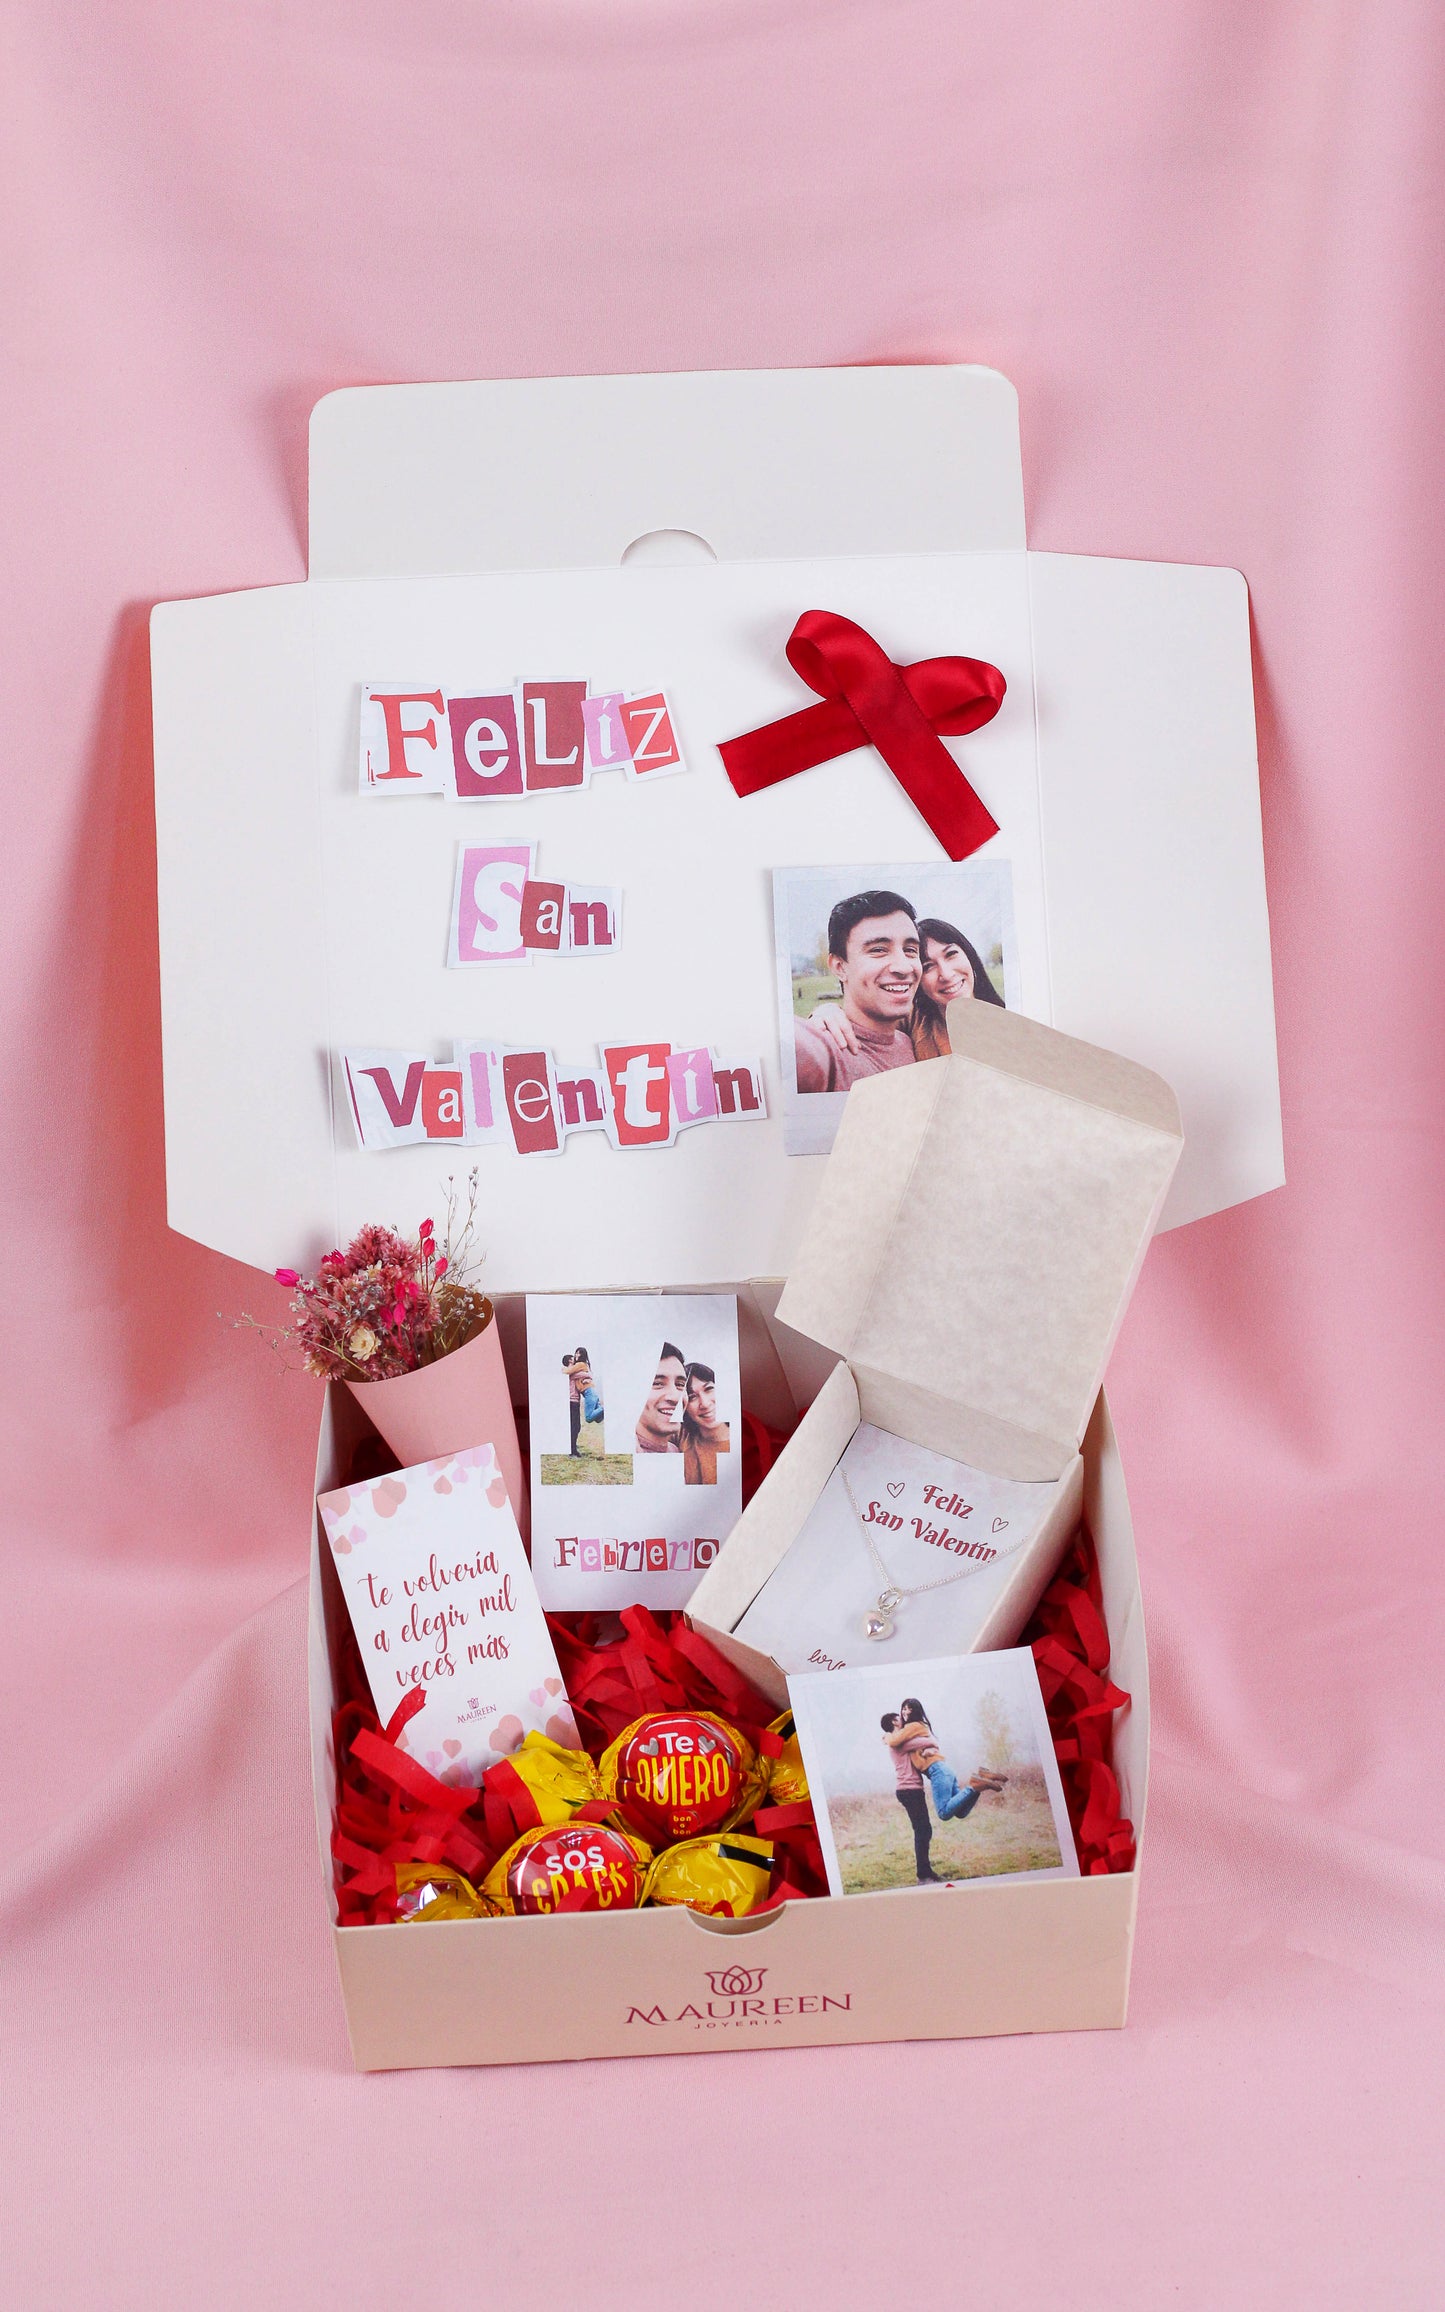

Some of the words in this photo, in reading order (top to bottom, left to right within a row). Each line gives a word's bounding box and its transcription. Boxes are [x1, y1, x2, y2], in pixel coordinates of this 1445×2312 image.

[472, 861, 613, 954] San
[541, 1342, 730, 1485] 14
[923, 1484, 974, 1519] Feliz
[555, 1537, 720, 1571] Febrero
[861, 1501, 904, 1531] San
[910, 1518, 997, 1563] Valentín
[404, 1551, 499, 1597] volvería
[374, 1629, 390, 1653] a
[401, 1603, 469, 1653] elegir
[480, 1574, 517, 1617] mil
[396, 1653, 456, 1687] veces
[468, 1634, 511, 1665] más
[457, 1704, 497, 1723] MAUREEN
[658, 1732, 694, 1754] Te
[635, 1753, 730, 1806] QUIERO
[545, 1846, 605, 1876] SOS
[623, 1993, 853, 2027] MAUREEN
